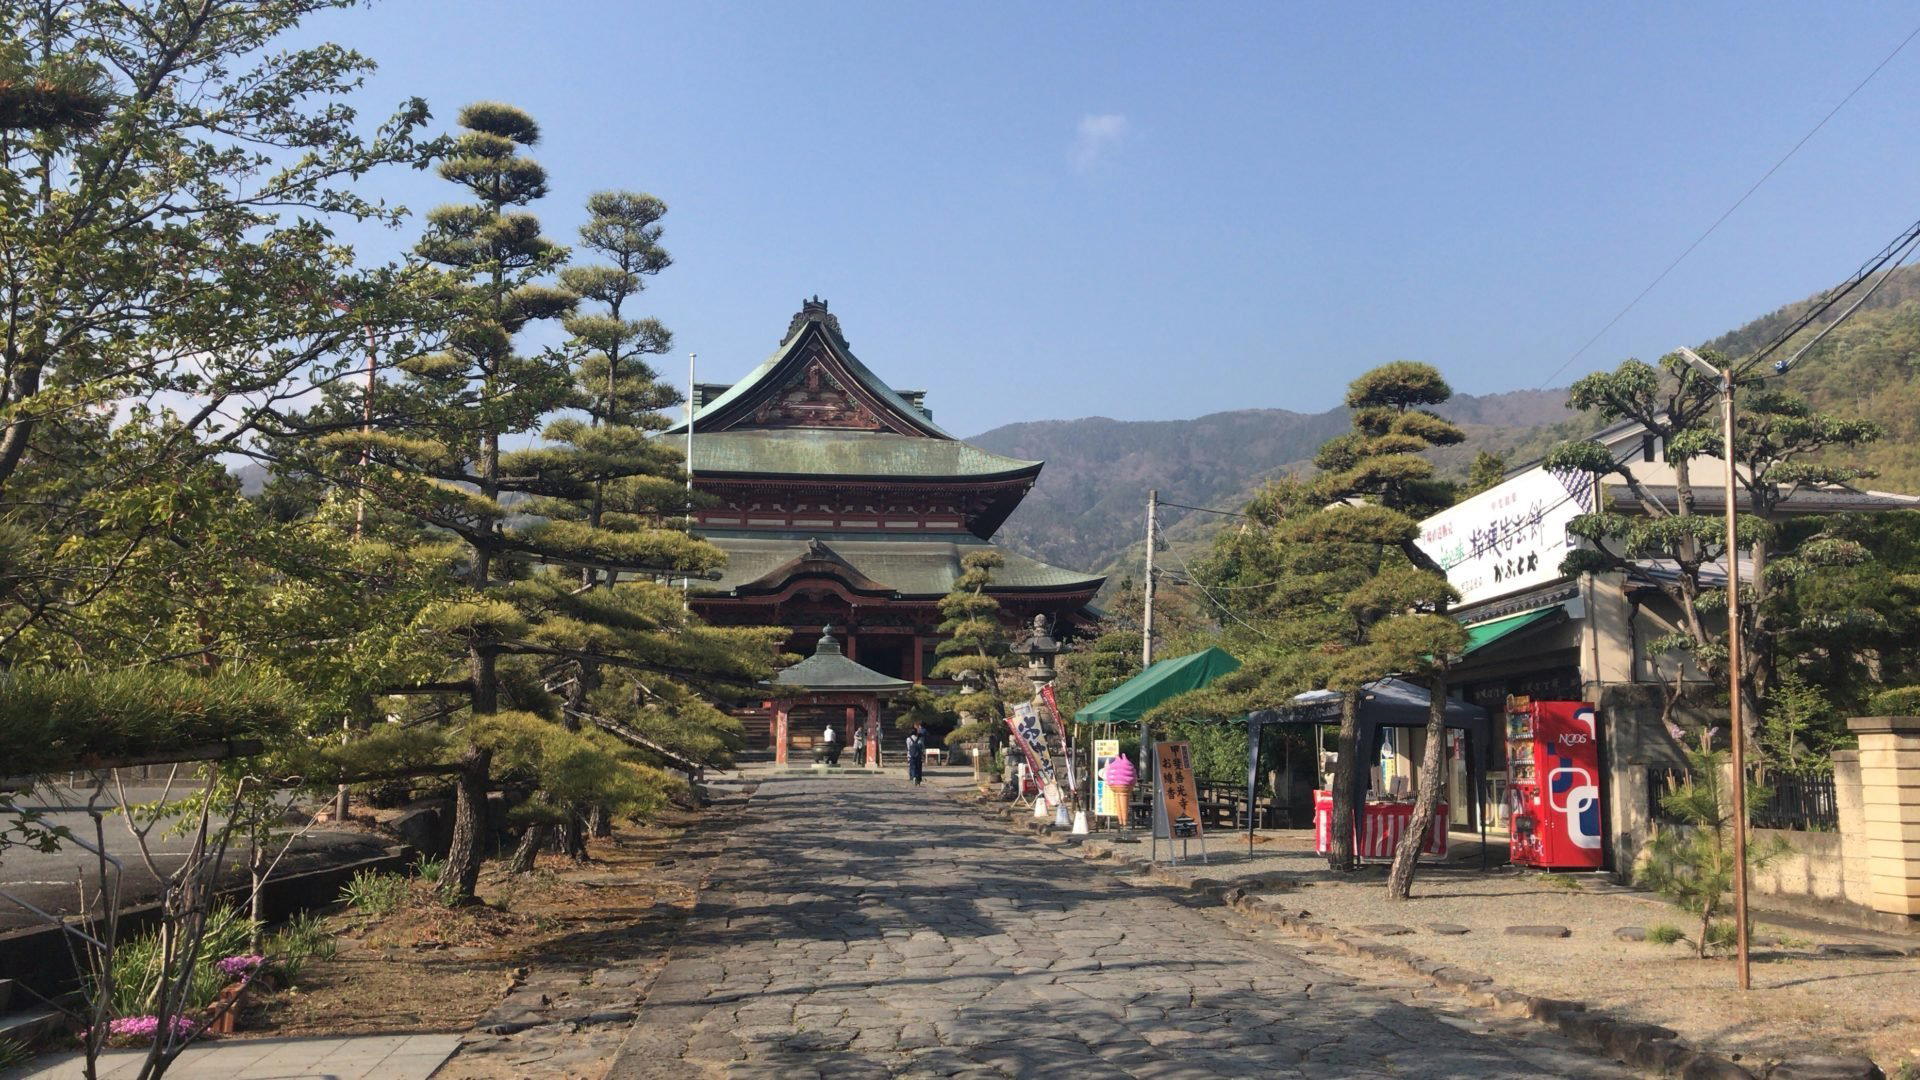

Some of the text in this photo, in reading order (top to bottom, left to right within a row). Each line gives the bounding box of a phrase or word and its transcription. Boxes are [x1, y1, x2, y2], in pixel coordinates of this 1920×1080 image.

[1162, 758, 1176, 800] お線香
[1170, 745, 1188, 809] 甲斐善光寺
